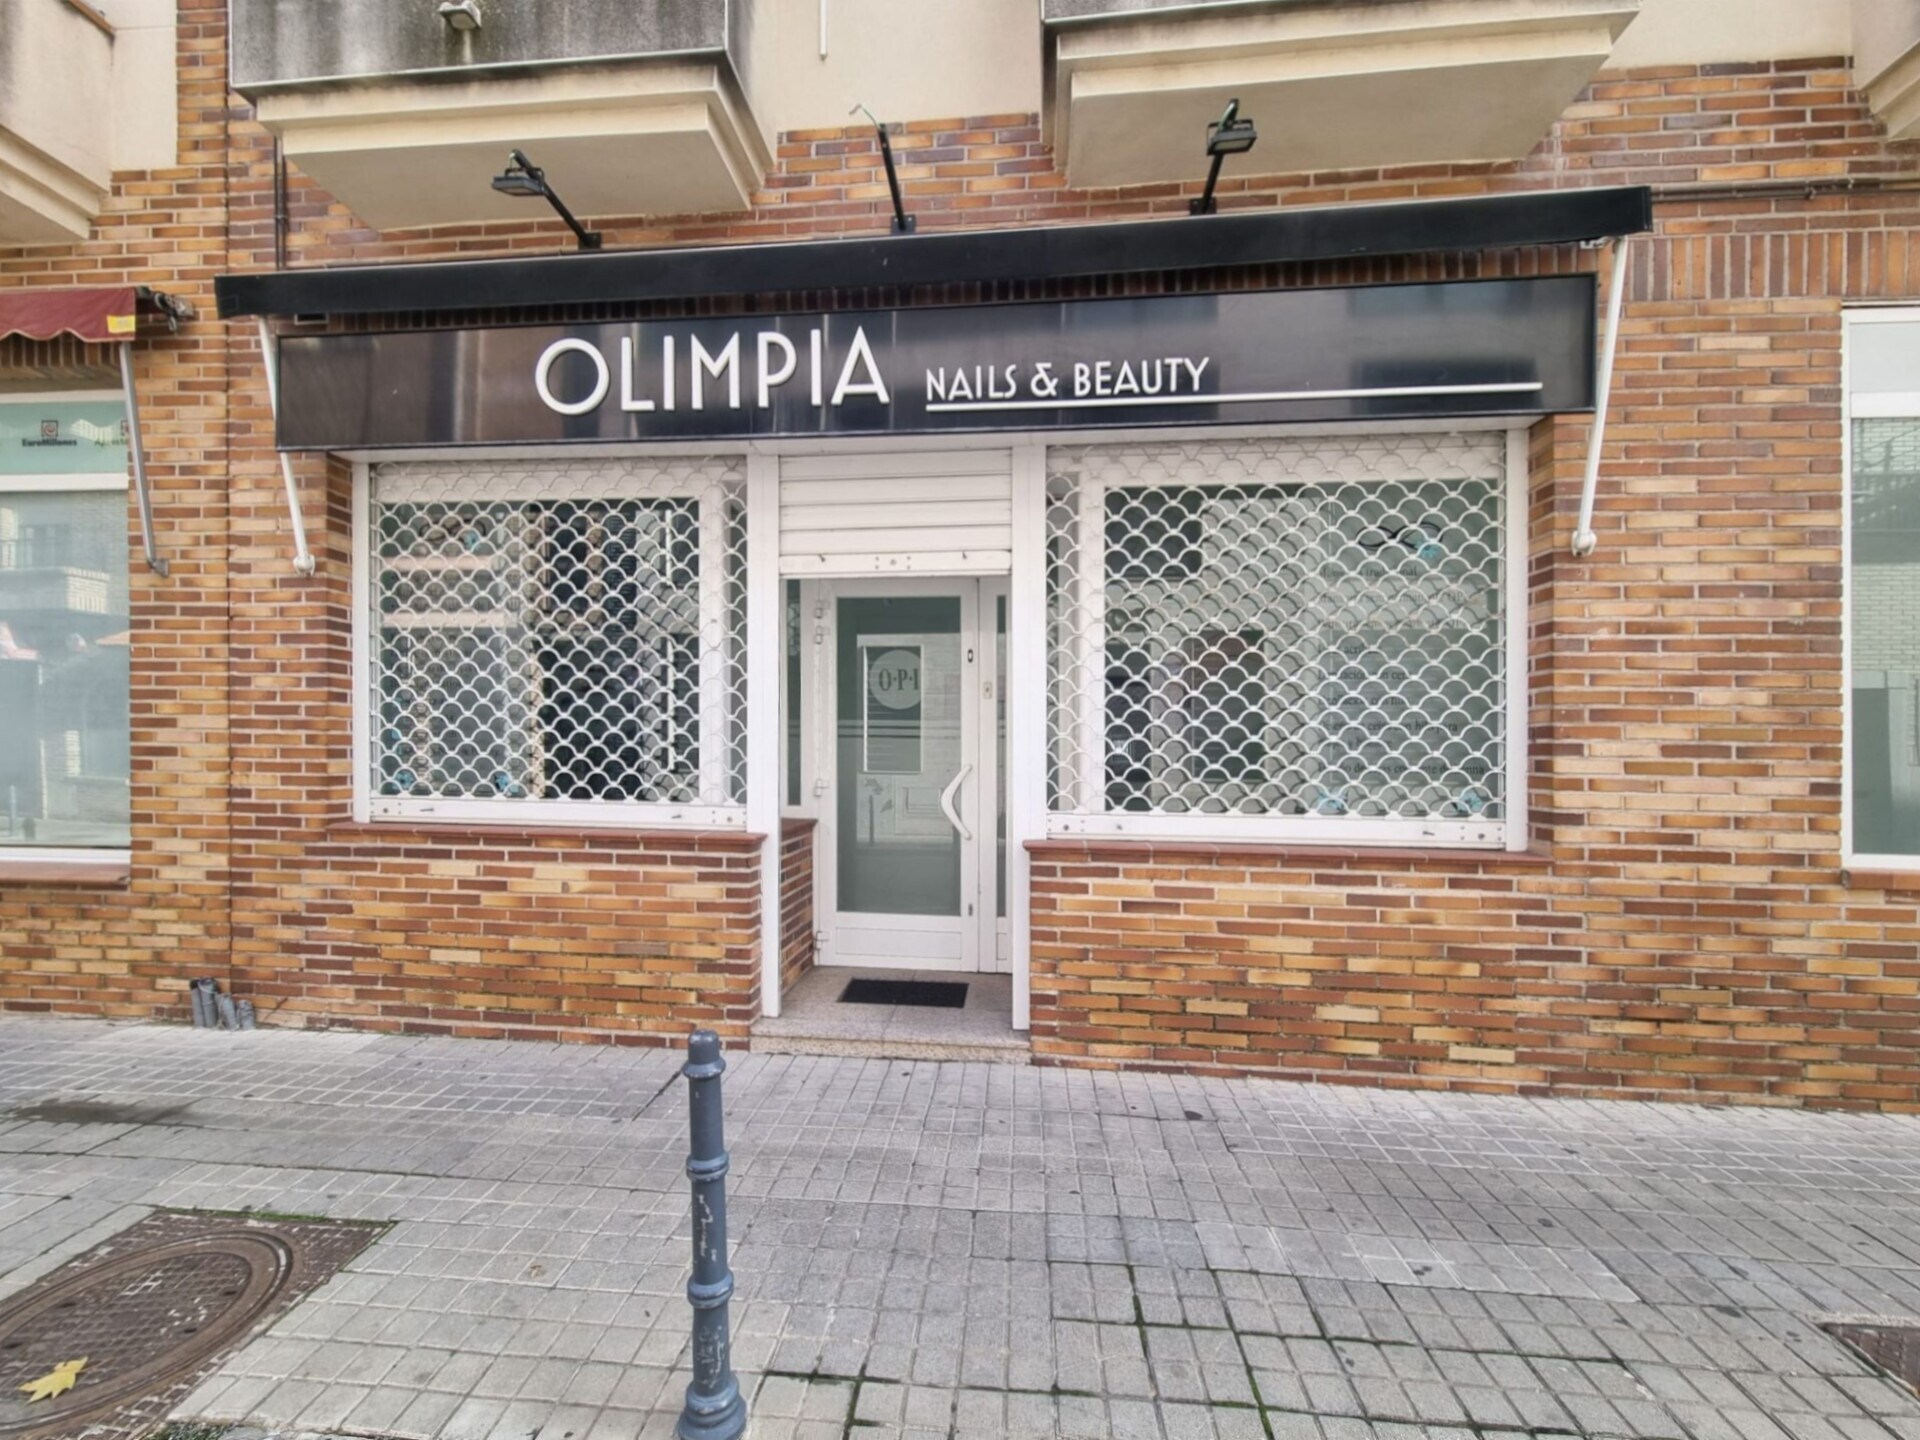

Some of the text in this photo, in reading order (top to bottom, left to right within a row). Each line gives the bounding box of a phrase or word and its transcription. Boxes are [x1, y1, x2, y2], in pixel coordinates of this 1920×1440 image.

[534, 325, 890, 415] OLIMPIA
[925, 356, 1210, 401] NAILS & BEAUTY
